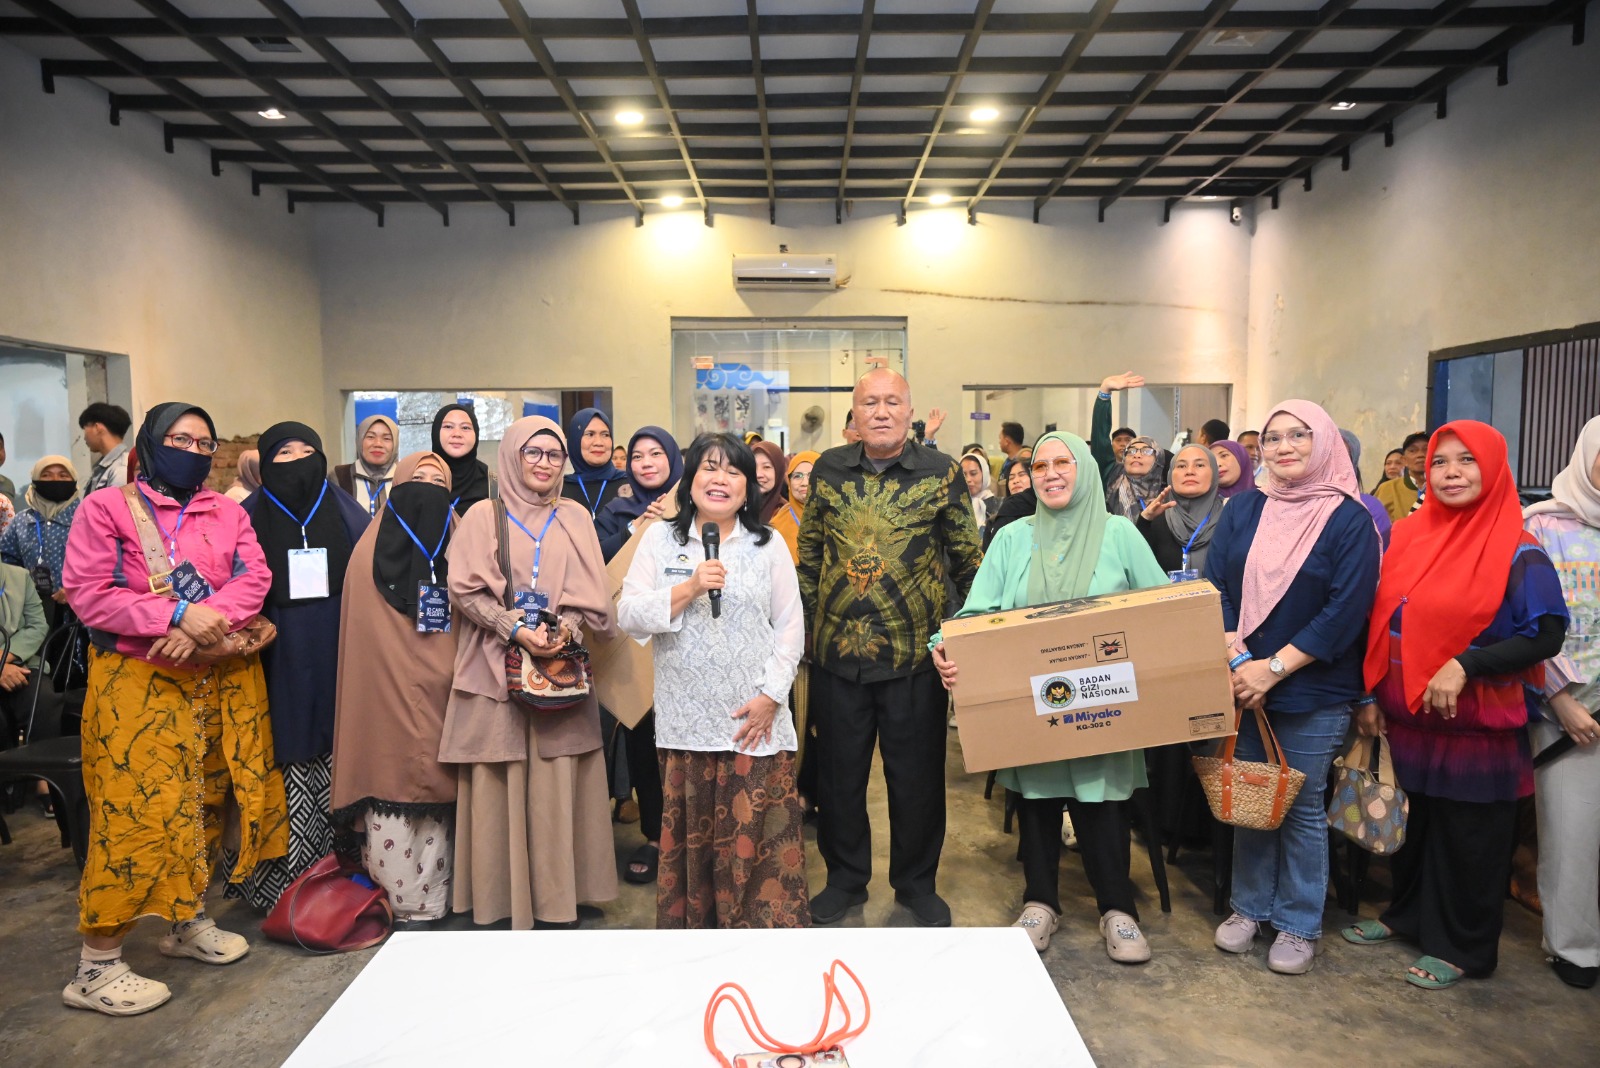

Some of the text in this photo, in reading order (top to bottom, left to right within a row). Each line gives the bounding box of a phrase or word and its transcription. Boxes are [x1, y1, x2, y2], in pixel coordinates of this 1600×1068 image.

[1079, 674, 1111, 685] BADAN
[1080, 683, 1100, 692] GIZI
[1081, 686, 1130, 699] NASIONAL
[1075, 708, 1122, 722] Miyako
[1076, 721, 1104, 731] KG-302
